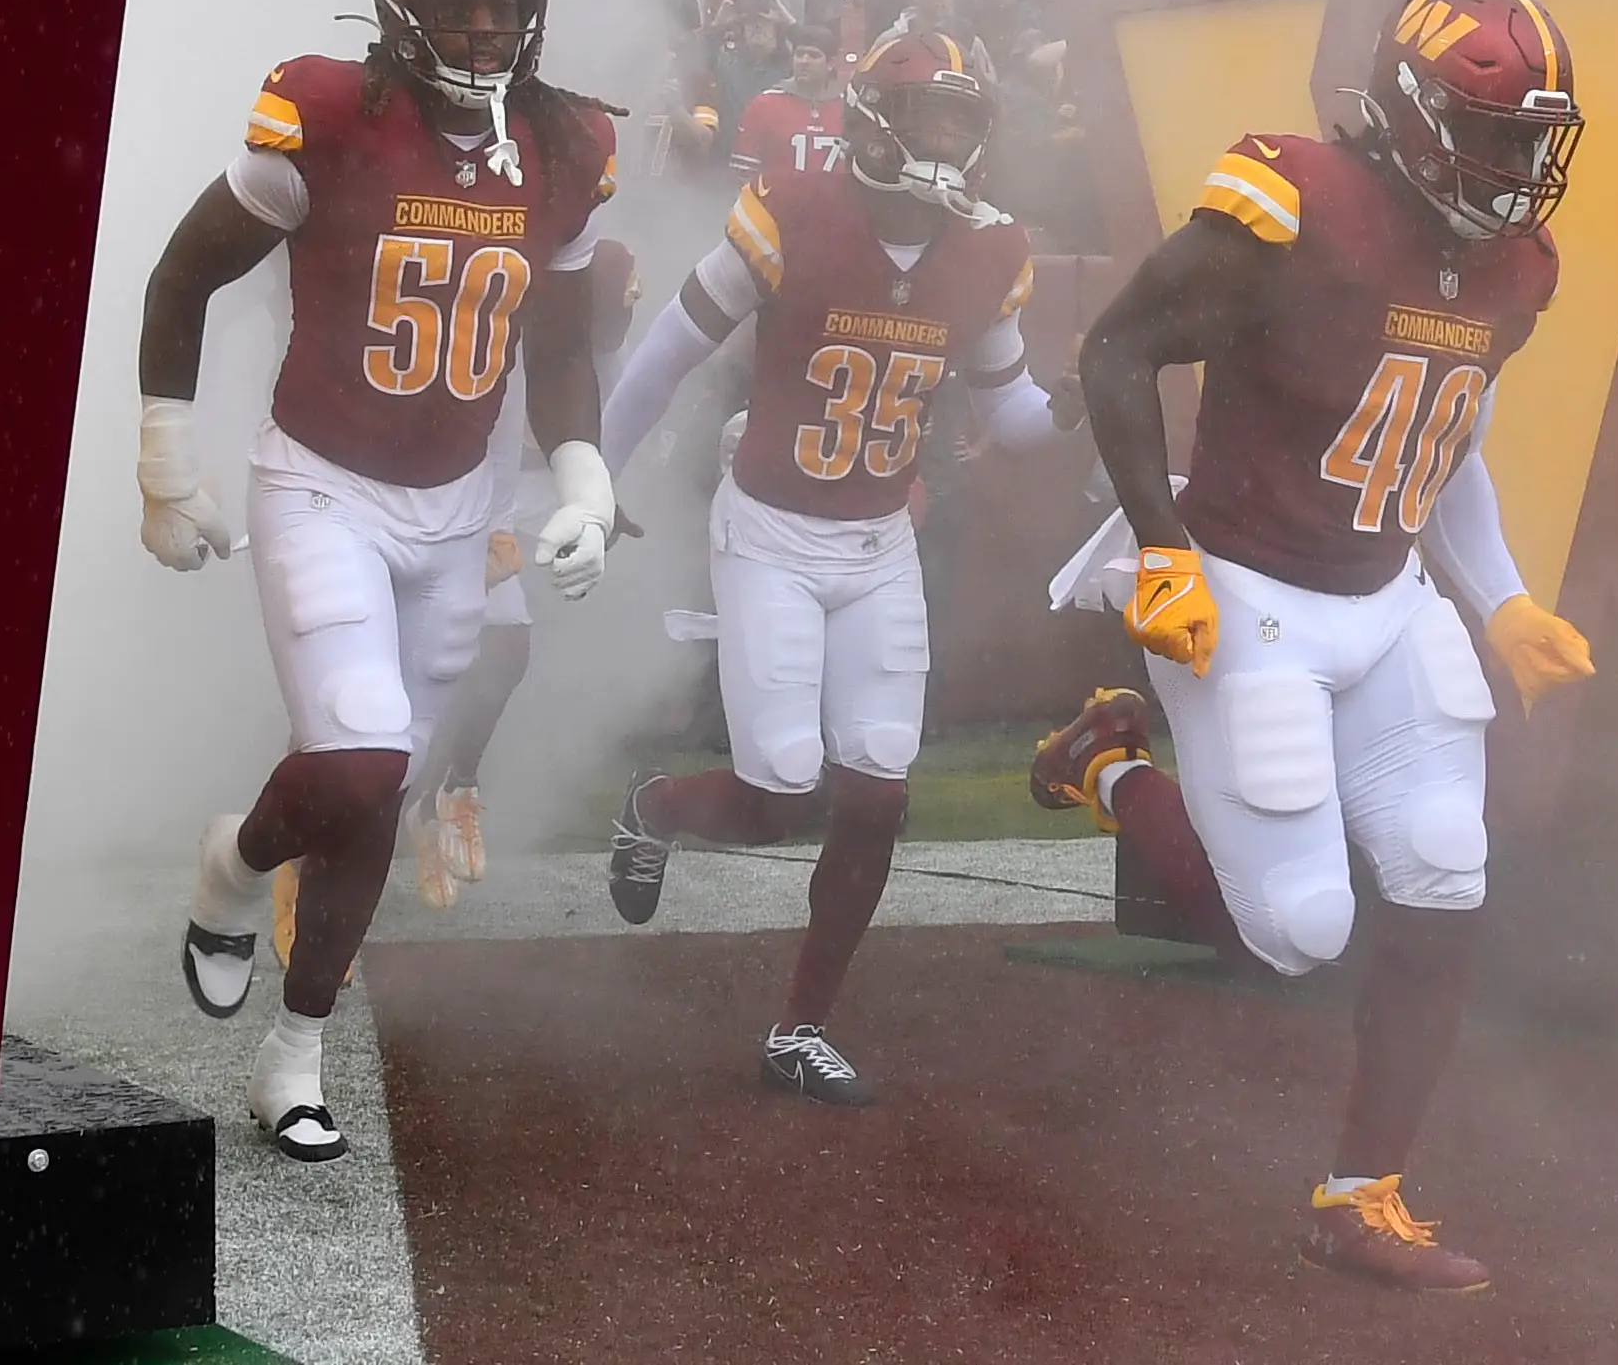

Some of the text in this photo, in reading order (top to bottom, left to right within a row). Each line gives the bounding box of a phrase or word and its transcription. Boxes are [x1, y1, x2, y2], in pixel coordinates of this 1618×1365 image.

[790, 133, 842, 173] 17
[394, 200, 526, 235] COMMANDERS
[362, 233, 532, 402] 50
[824, 312, 949, 348] COMMANDERS
[1384, 310, 1493, 355] COMMANDERS
[793, 344, 947, 481] 35
[1320, 352, 1488, 534] 40
